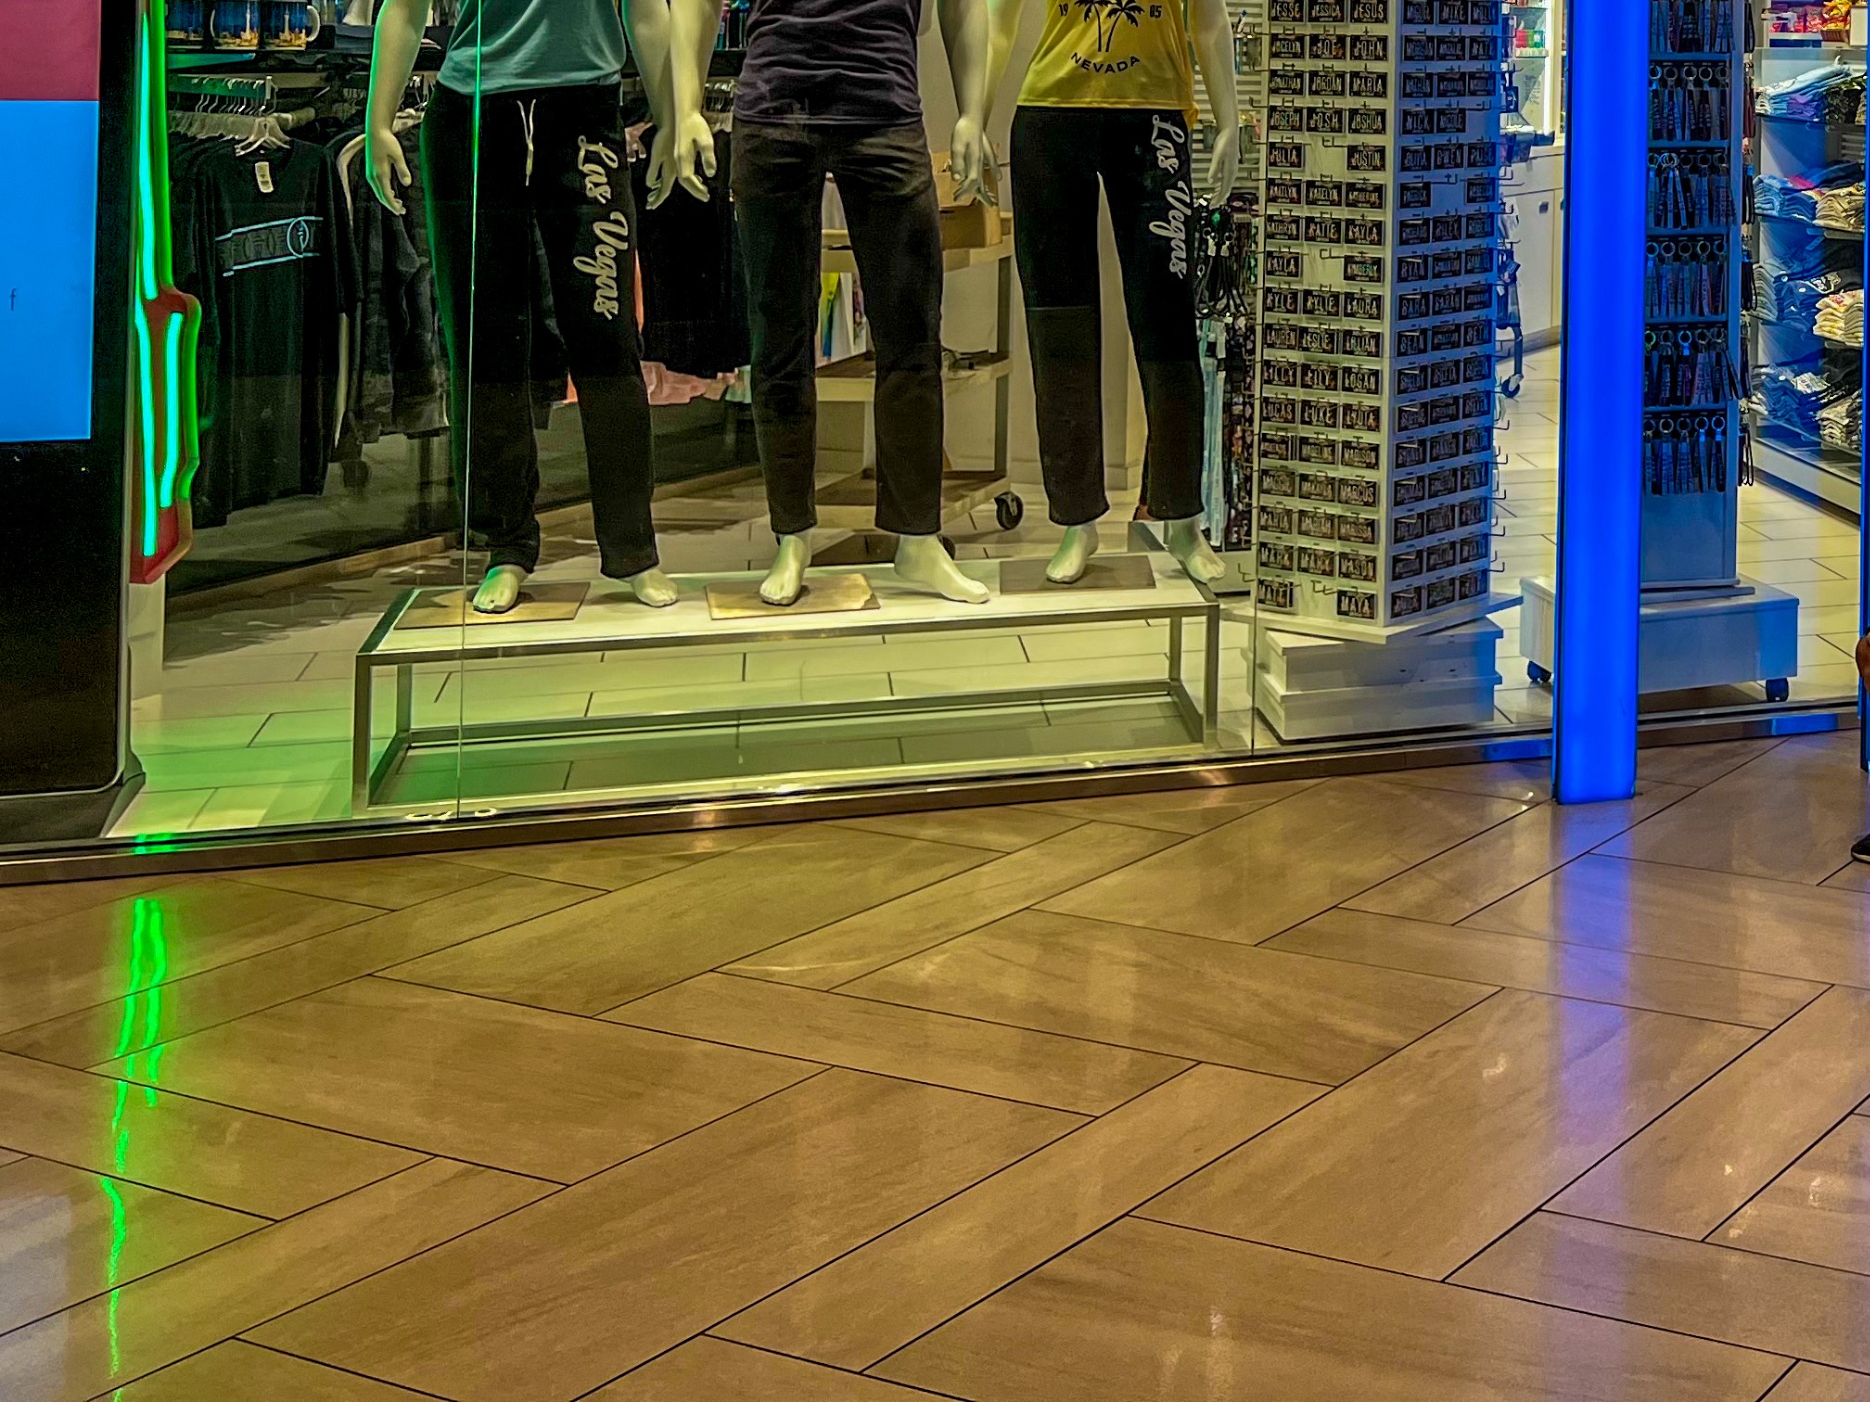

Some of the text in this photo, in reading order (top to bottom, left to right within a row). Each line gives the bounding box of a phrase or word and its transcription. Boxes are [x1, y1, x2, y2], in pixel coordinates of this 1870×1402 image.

[1059, 3, 1069, 17] 19
[1271, 2, 1300, 18] JESSE
[1311, 4, 1341, 18] JESSICA
[1354, 3, 1384, 19] JESUS
[1315, 39, 1339, 55] JOE
[1354, 40, 1384, 57] JOHN
[1070, 52, 1141, 74] NEVADA
[1270, 111, 1300, 126] JOSEPH
[1309, 112, 1339, 128] JOSH
[1351, 114, 1383, 130] JOSHUA
[1269, 148, 1298, 163] JULIA
[1350, 151, 1381, 167] JUSTIN
[1148, 114, 1192, 280] Las Vegas
[573, 135, 629, 320] Las Vegas
[1308, 222, 1338, 239] KATIE
[1348, 224, 1378, 240] KAYLA
[1267, 257, 1296, 273] KAYLA
[1266, 293, 1296, 311] KYLE
[1306, 295, 1338, 313] KYLIE
[1347, 298, 1378, 316] LAURA
[1266, 329, 1296, 346] LAUREN
[1302, 333, 1333, 349] LESLIE
[1344, 372, 1376, 389] LOGAN
[1262, 401, 1293, 421] LUCAS
[1304, 405, 1335, 424] LUKE
[1343, 448, 1376, 463] MADISON
[1340, 485, 1375, 503] MARCUS
[1340, 558, 1375, 576] MASON
[1340, 595, 1373, 611] MAYA
